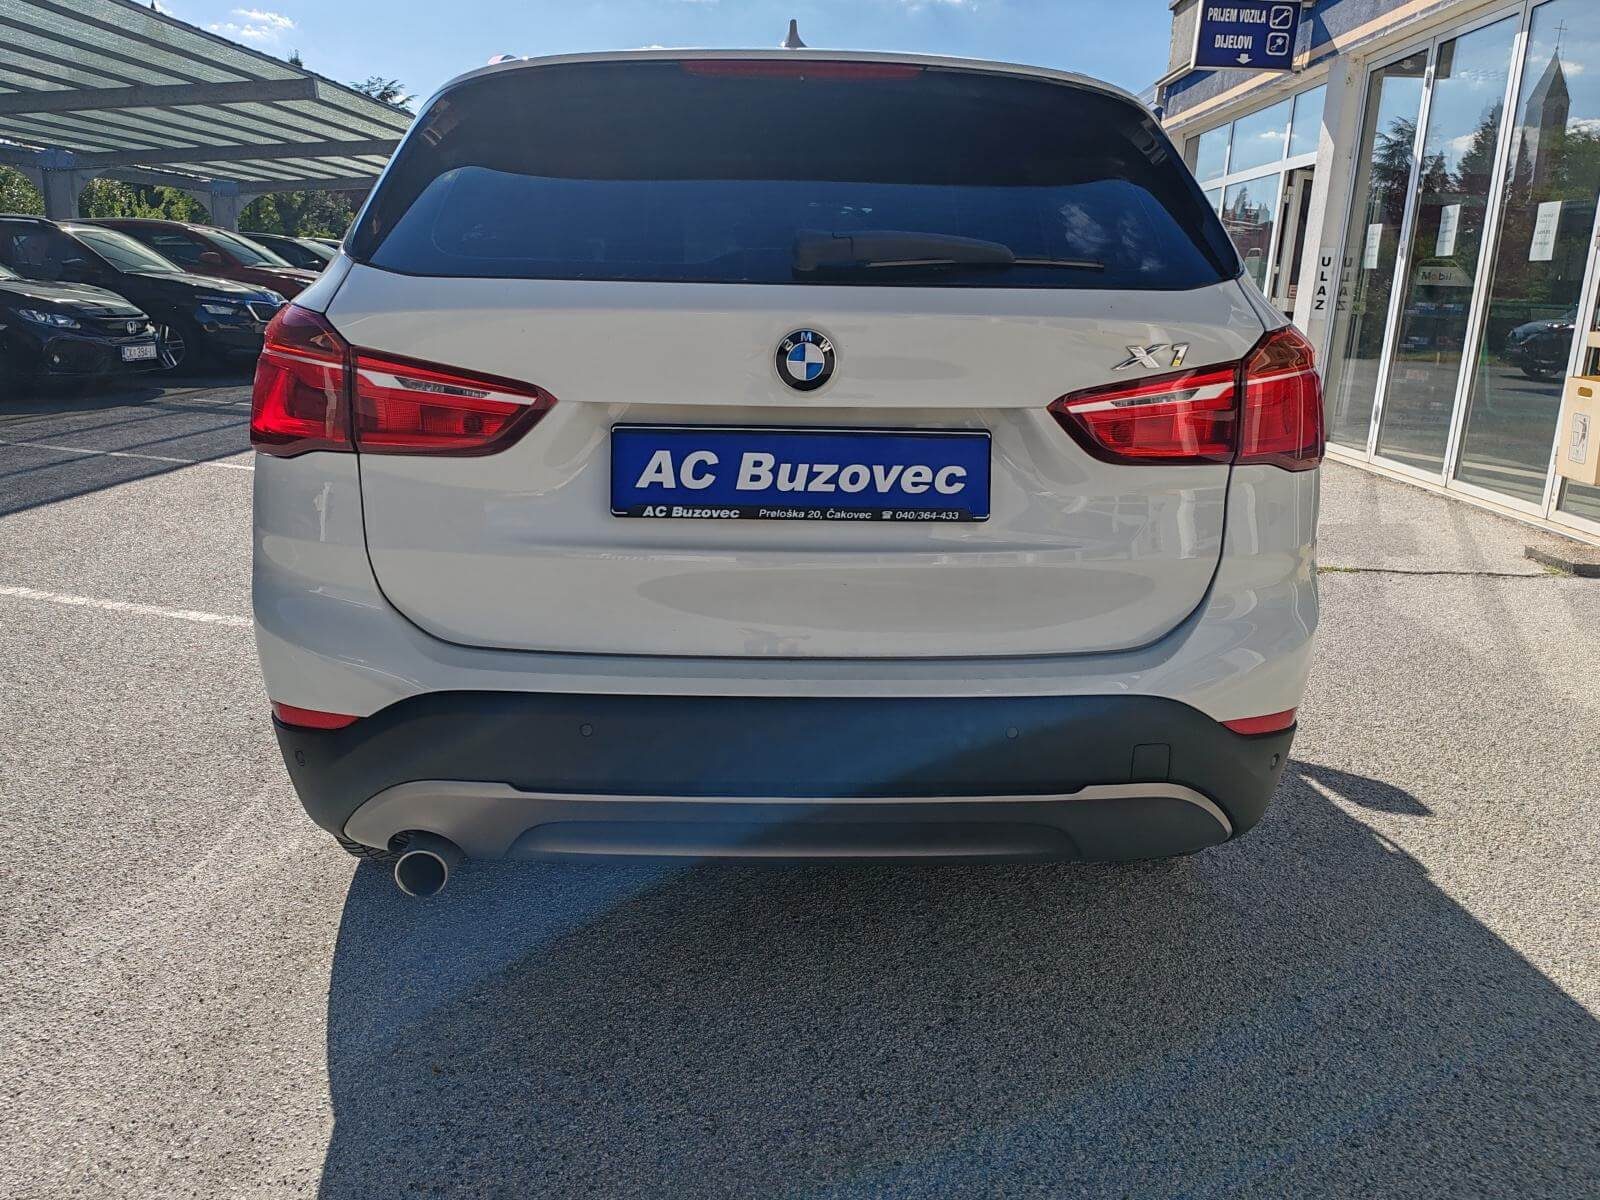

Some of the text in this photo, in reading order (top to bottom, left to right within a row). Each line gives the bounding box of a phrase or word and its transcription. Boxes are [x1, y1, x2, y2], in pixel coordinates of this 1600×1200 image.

[1207, 7, 1266, 24] PRIJEM VOZILA
[1214, 34, 1253, 49] DIJELOVI
[1314, 256, 1332, 310] ULAZ
[783, 331, 833, 353] BMW
[1111, 342, 1190, 371] X1
[635, 449, 967, 494] AC Buzovec
[643, 506, 959, 521] AC Buzovec Preloška 20, Čakovec 040/364-433
